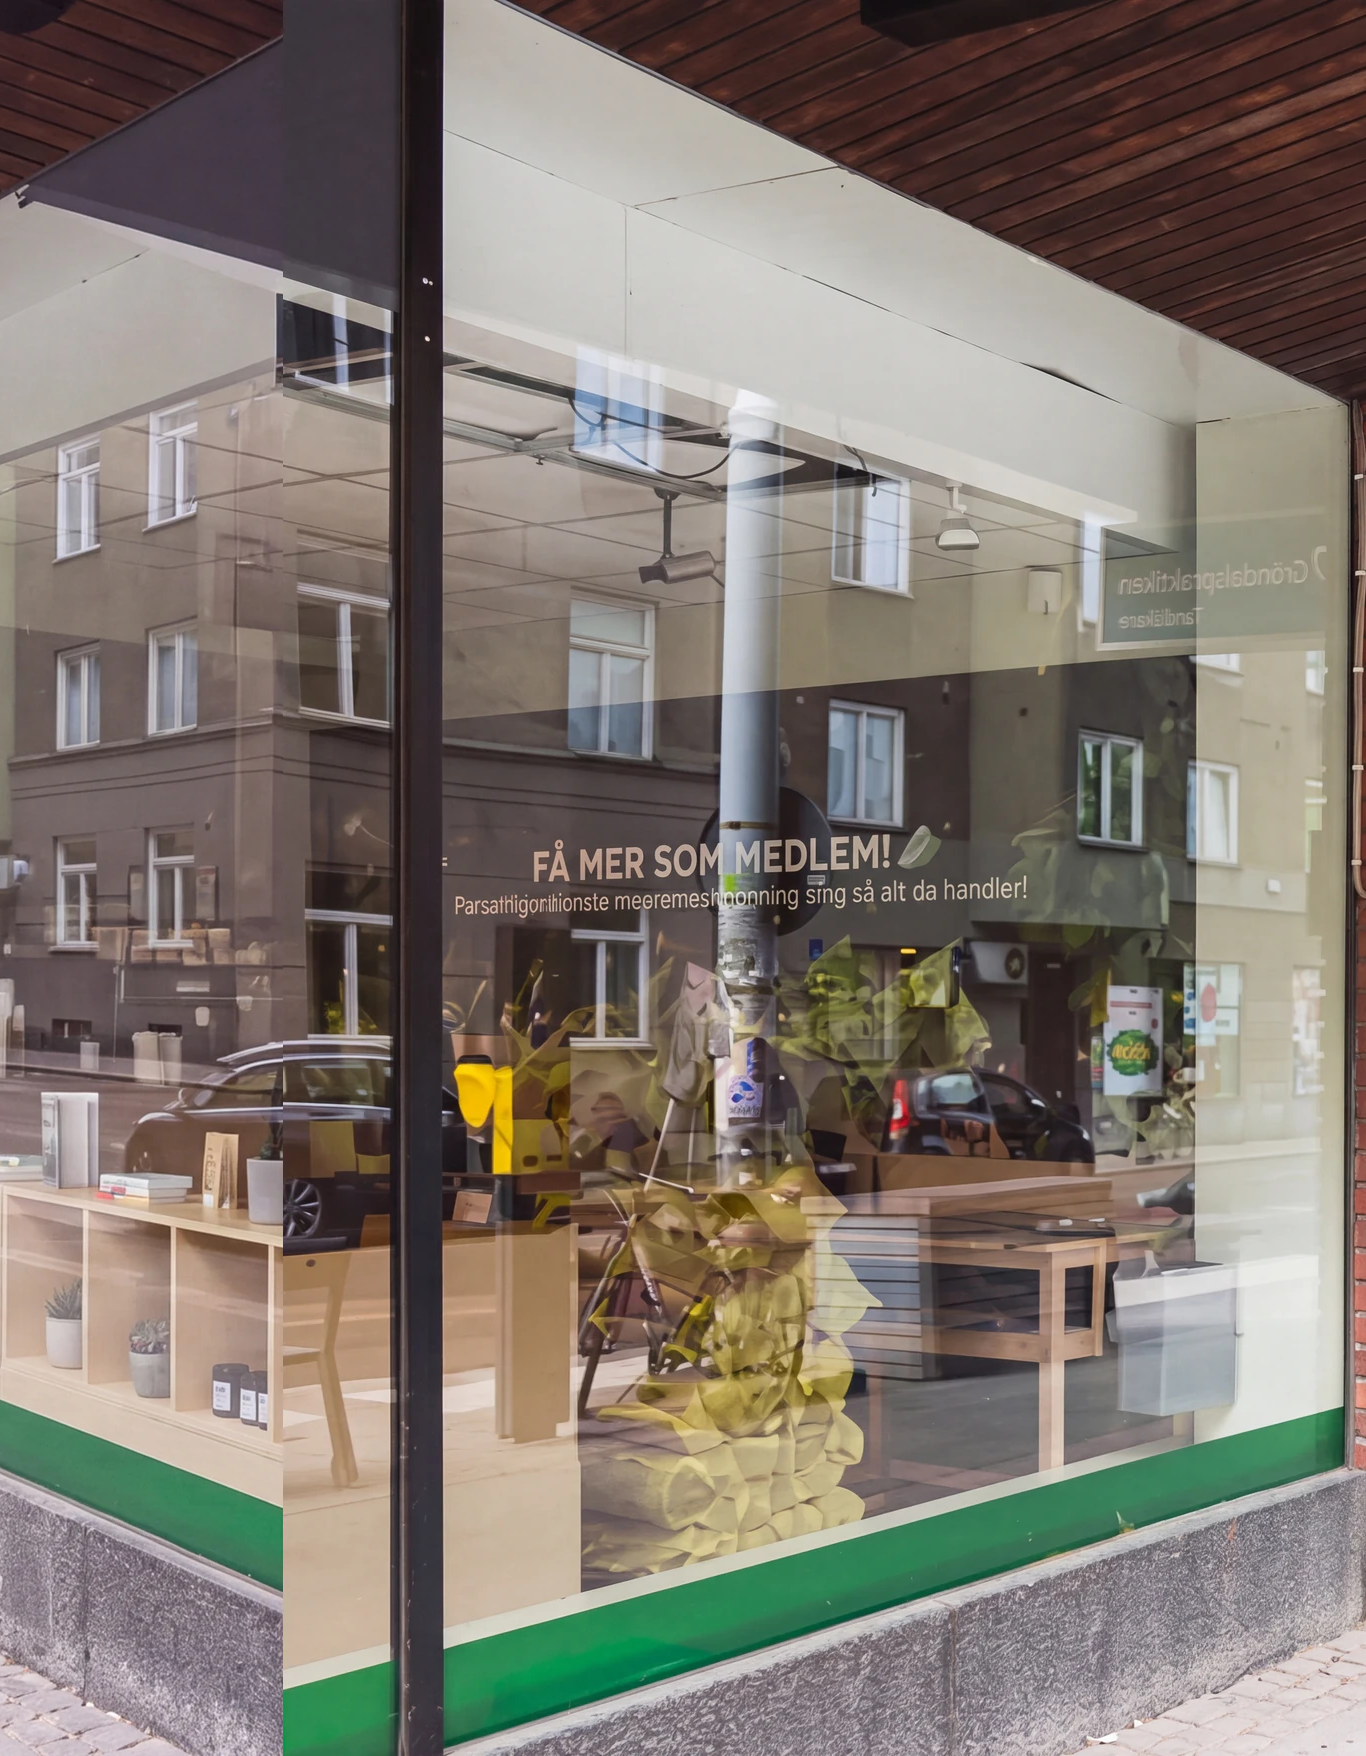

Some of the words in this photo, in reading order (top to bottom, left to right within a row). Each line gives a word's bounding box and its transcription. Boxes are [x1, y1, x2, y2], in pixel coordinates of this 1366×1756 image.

[533, 838, 570, 883] FÅ
[579, 846, 644, 881] MER
[653, 842, 724, 878] SOM
[735, 833, 891, 875] MEDLEM!
[852, 879, 875, 903] så
[881, 880, 906, 902] alt
[913, 878, 937, 901] da
[943, 874, 1028, 900] handler!
